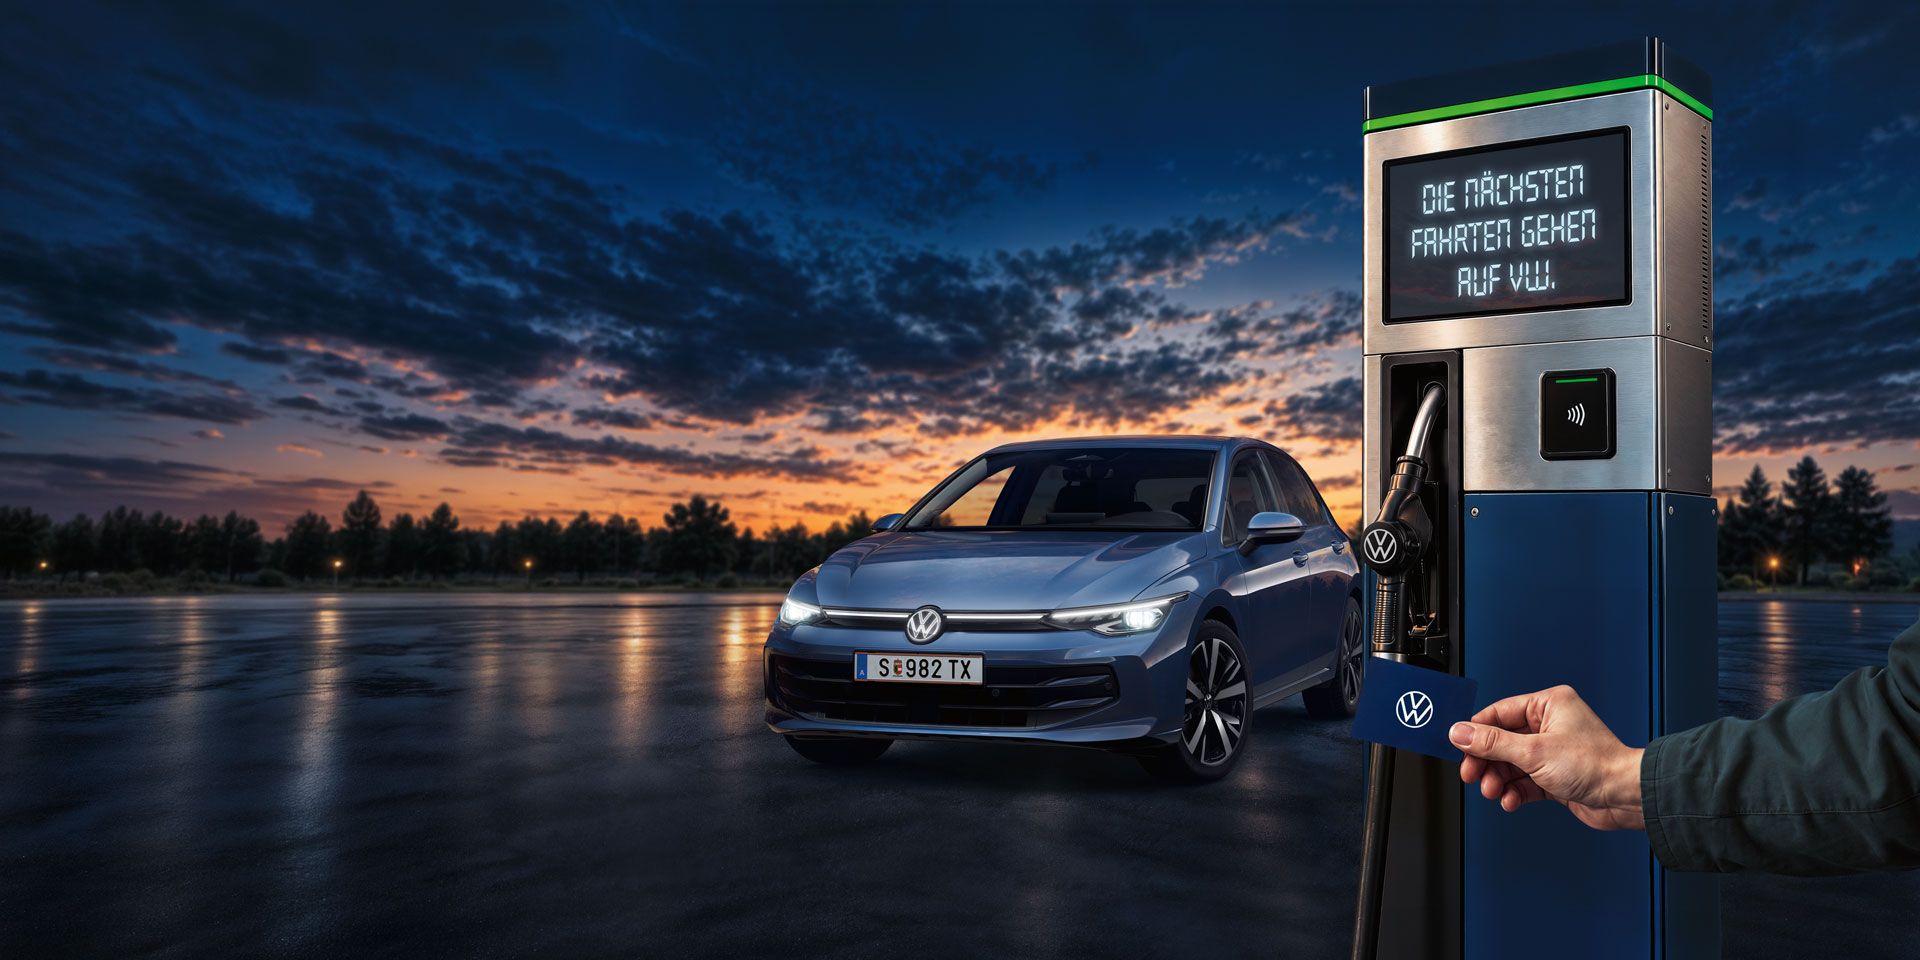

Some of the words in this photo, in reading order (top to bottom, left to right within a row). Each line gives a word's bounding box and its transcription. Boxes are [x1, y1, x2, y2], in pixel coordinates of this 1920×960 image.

[1423, 181, 1456, 214] DIE
[1464, 164, 1584, 209] NÄCHSTEN
[1411, 219, 1511, 259] FAHRTEN
[1521, 209, 1596, 248] GEHEN
[1458, 264, 1501, 297] AUF
[1509, 260, 1555, 292] VW.
[1364, 529, 1397, 563] VW
[907, 608, 941, 641] VW
[906, 659, 941, 678] 982
[949, 660, 971, 679] TX
[1396, 691, 1433, 728] VW
